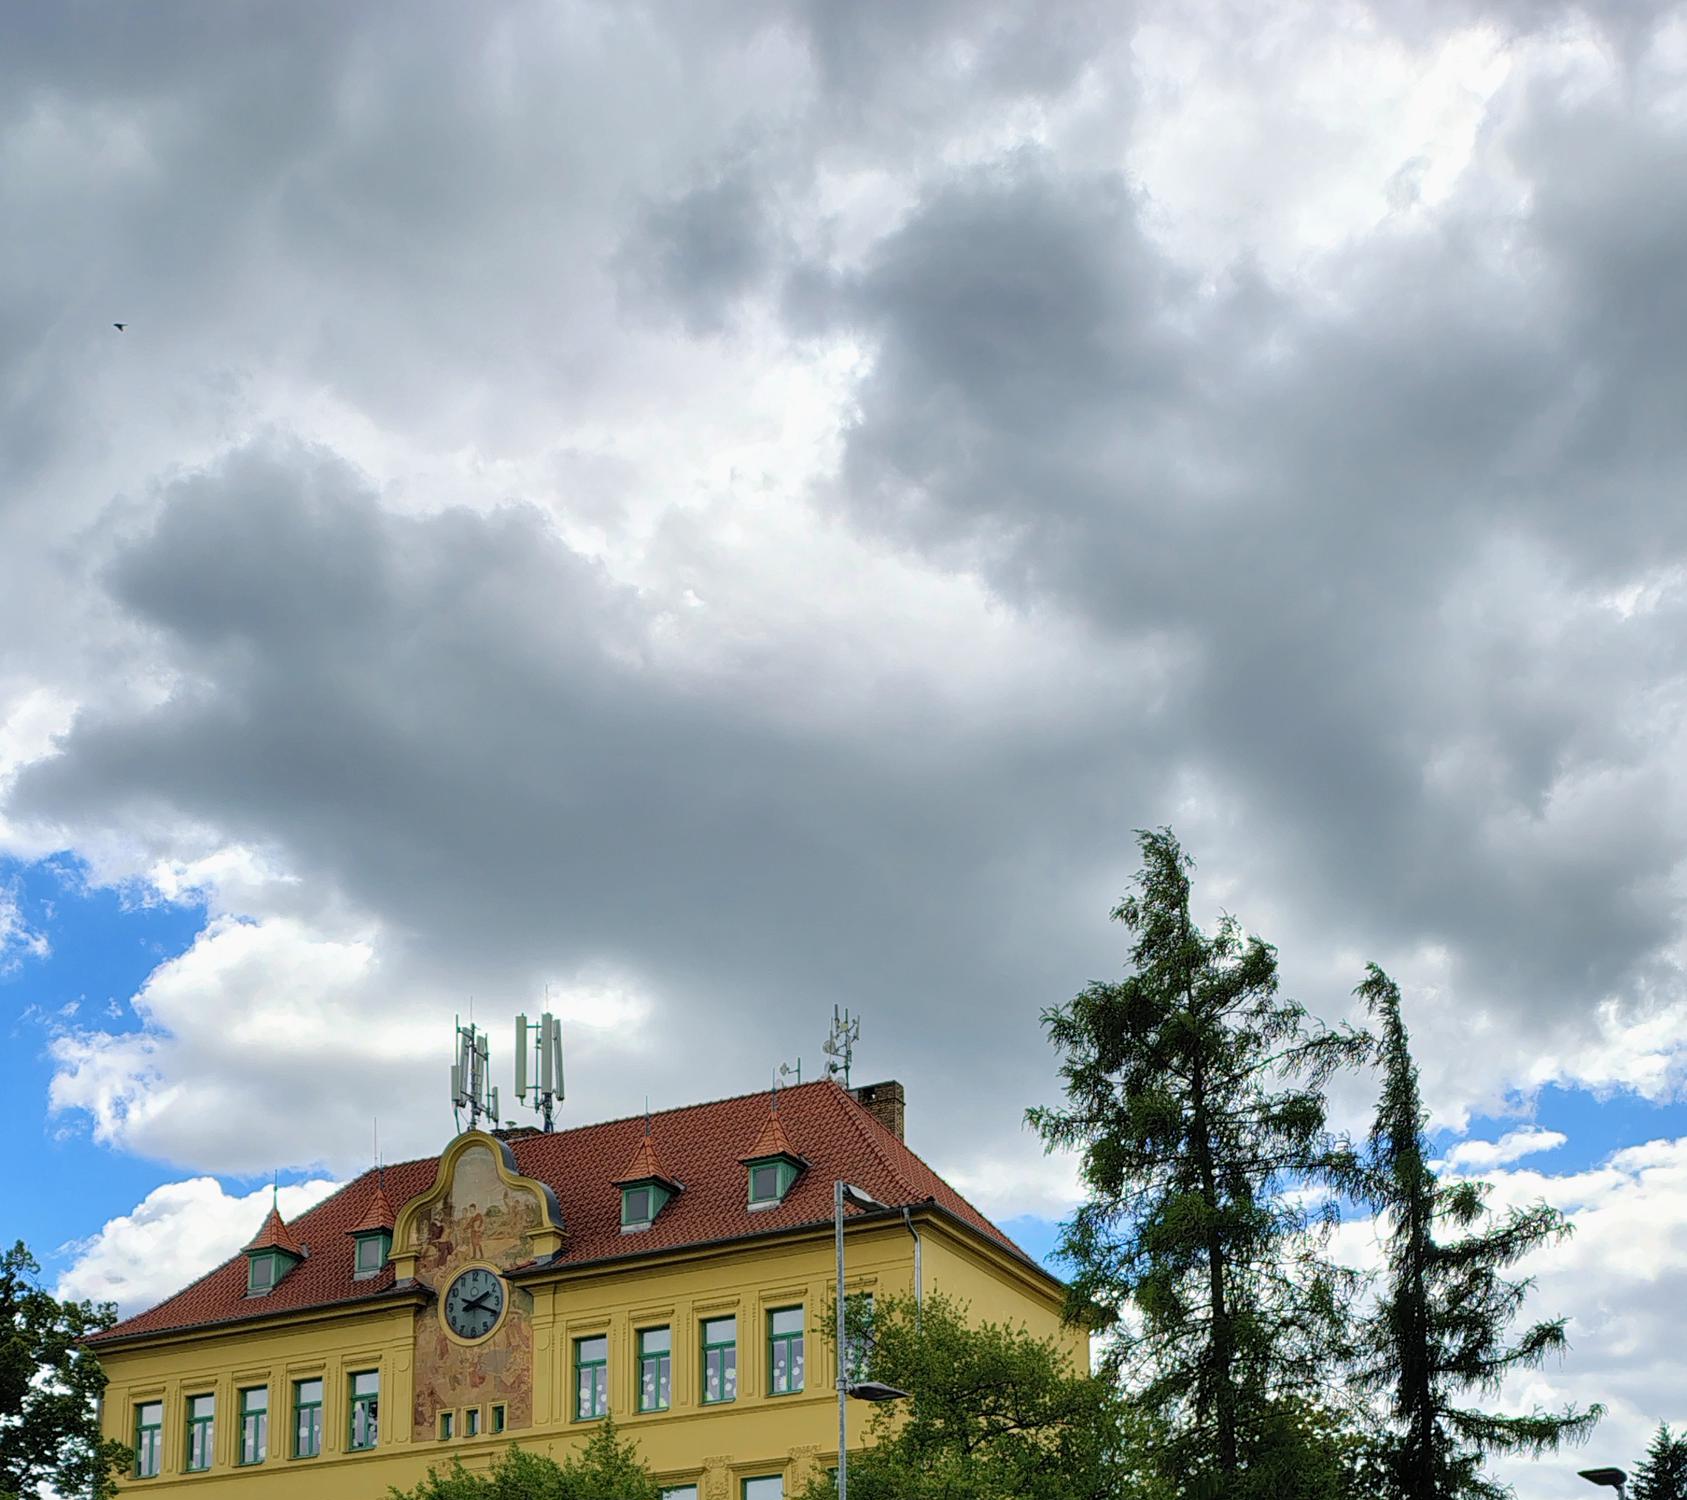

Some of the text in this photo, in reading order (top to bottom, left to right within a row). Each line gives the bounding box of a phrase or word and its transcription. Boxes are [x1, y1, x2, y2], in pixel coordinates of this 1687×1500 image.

[472, 1271, 479, 1282] 12
[461, 1277, 466, 1288] 11
[491, 1282, 497, 1293] 2
[452, 1287, 459, 1298] 10
[494, 1295, 500, 1306] 3
[448, 1302, 454, 1313] 9
[451, 1315, 457, 1326] 8
[460, 1325, 466, 1334] 7
[470, 1326, 477, 1337] 6
[482, 1321, 489, 1332] 5
